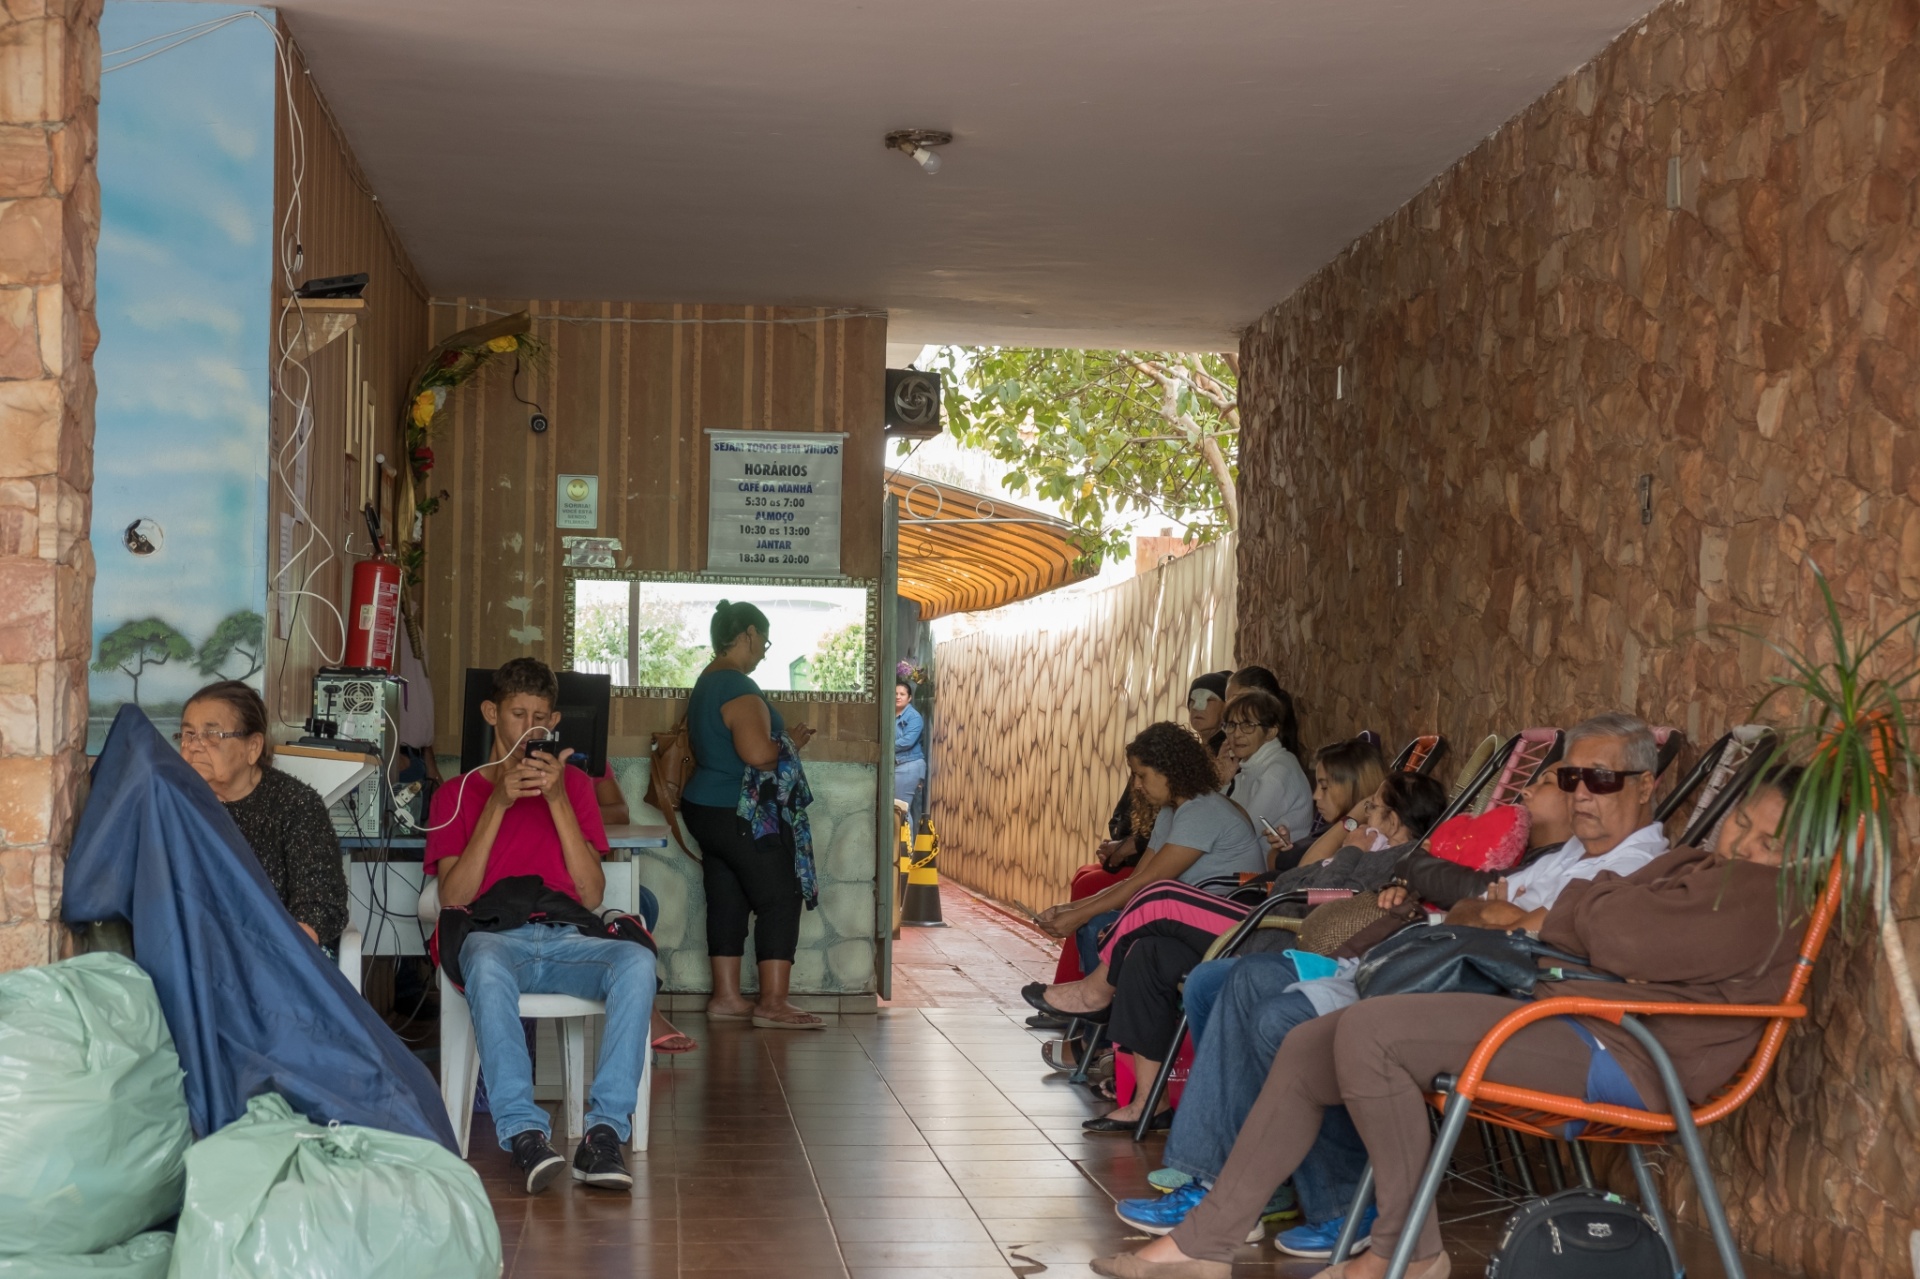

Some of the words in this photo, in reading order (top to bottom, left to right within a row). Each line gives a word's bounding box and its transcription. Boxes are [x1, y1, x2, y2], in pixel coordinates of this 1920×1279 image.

[714, 442, 744, 452] SEJAM
[747, 443, 777, 453] TODOS
[781, 444, 801, 454] BEM
[804, 445, 839, 455] VINDOS
[744, 461, 808, 477] HORÁRIOS
[738, 481, 760, 492] CAFÉ
[762, 483, 775, 493] DA
[778, 482, 813, 494] MANHÃ
[745, 497, 767, 507] 5:30
[784, 498, 805, 508] 7:00
[755, 511, 794, 524] ALMOÇO
[740, 525, 766, 535] 10:30
[784, 526, 810, 536] 13:00
[756, 540, 792, 550] JANTAR
[739, 553, 766, 564] 18:30
[768, 556, 780, 564] as
[782, 554, 810, 564] 20:00
